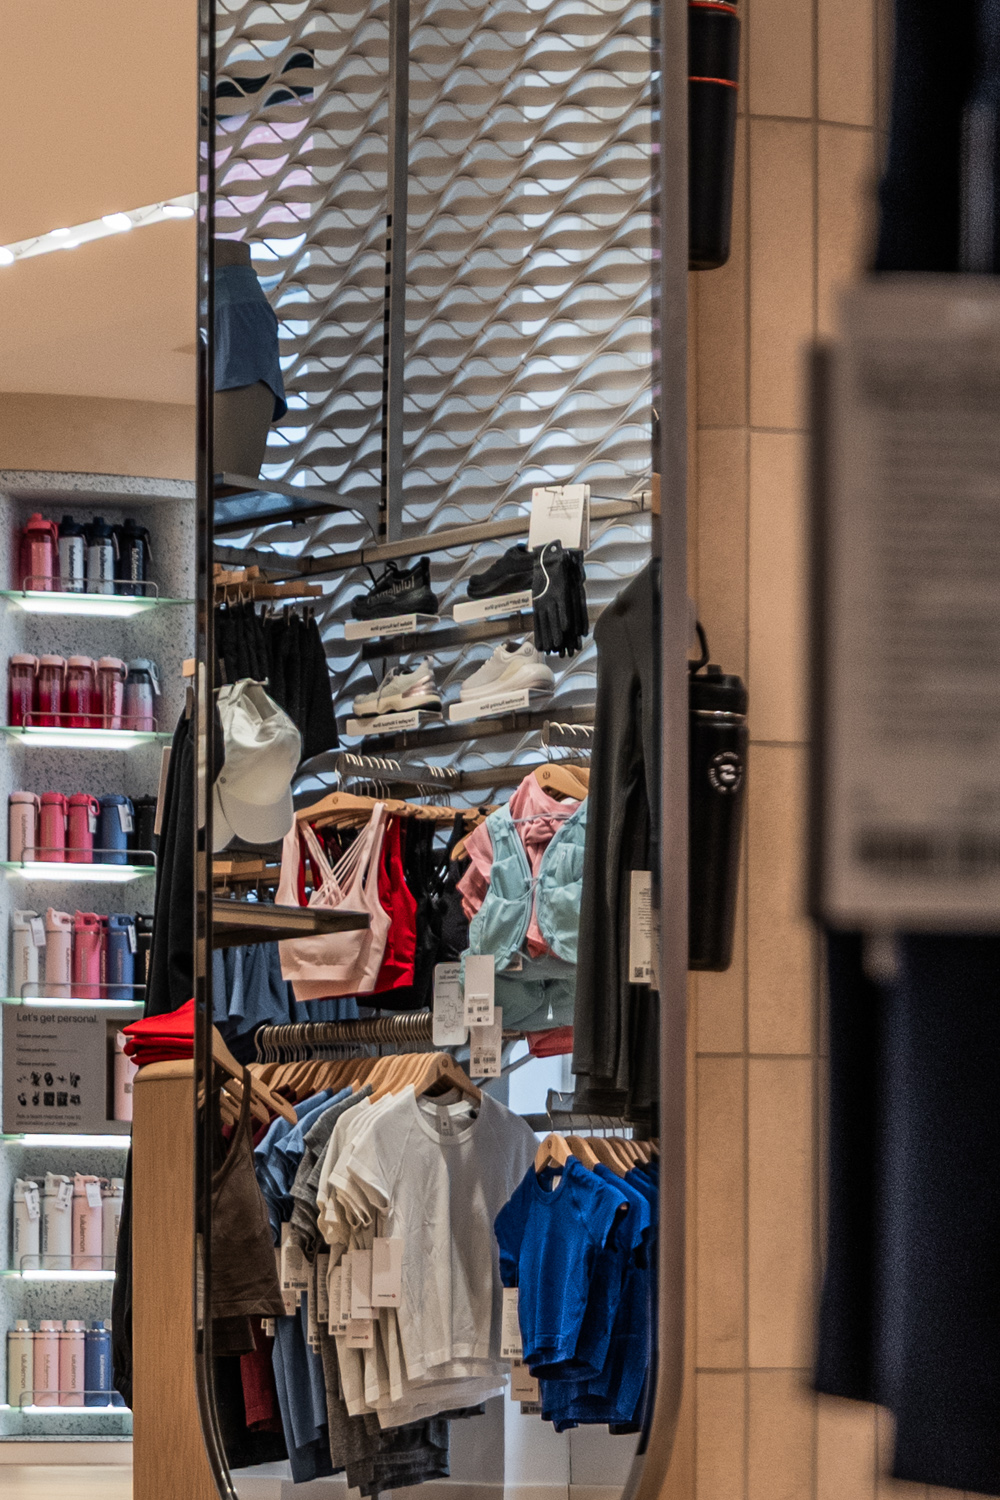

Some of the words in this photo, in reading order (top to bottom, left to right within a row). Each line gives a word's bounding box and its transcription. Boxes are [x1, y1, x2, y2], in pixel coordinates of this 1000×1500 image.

[16, 1013, 38, 1022] Let's
[40, 1014, 56, 1024] get
[57, 1014, 99, 1023] personal.
